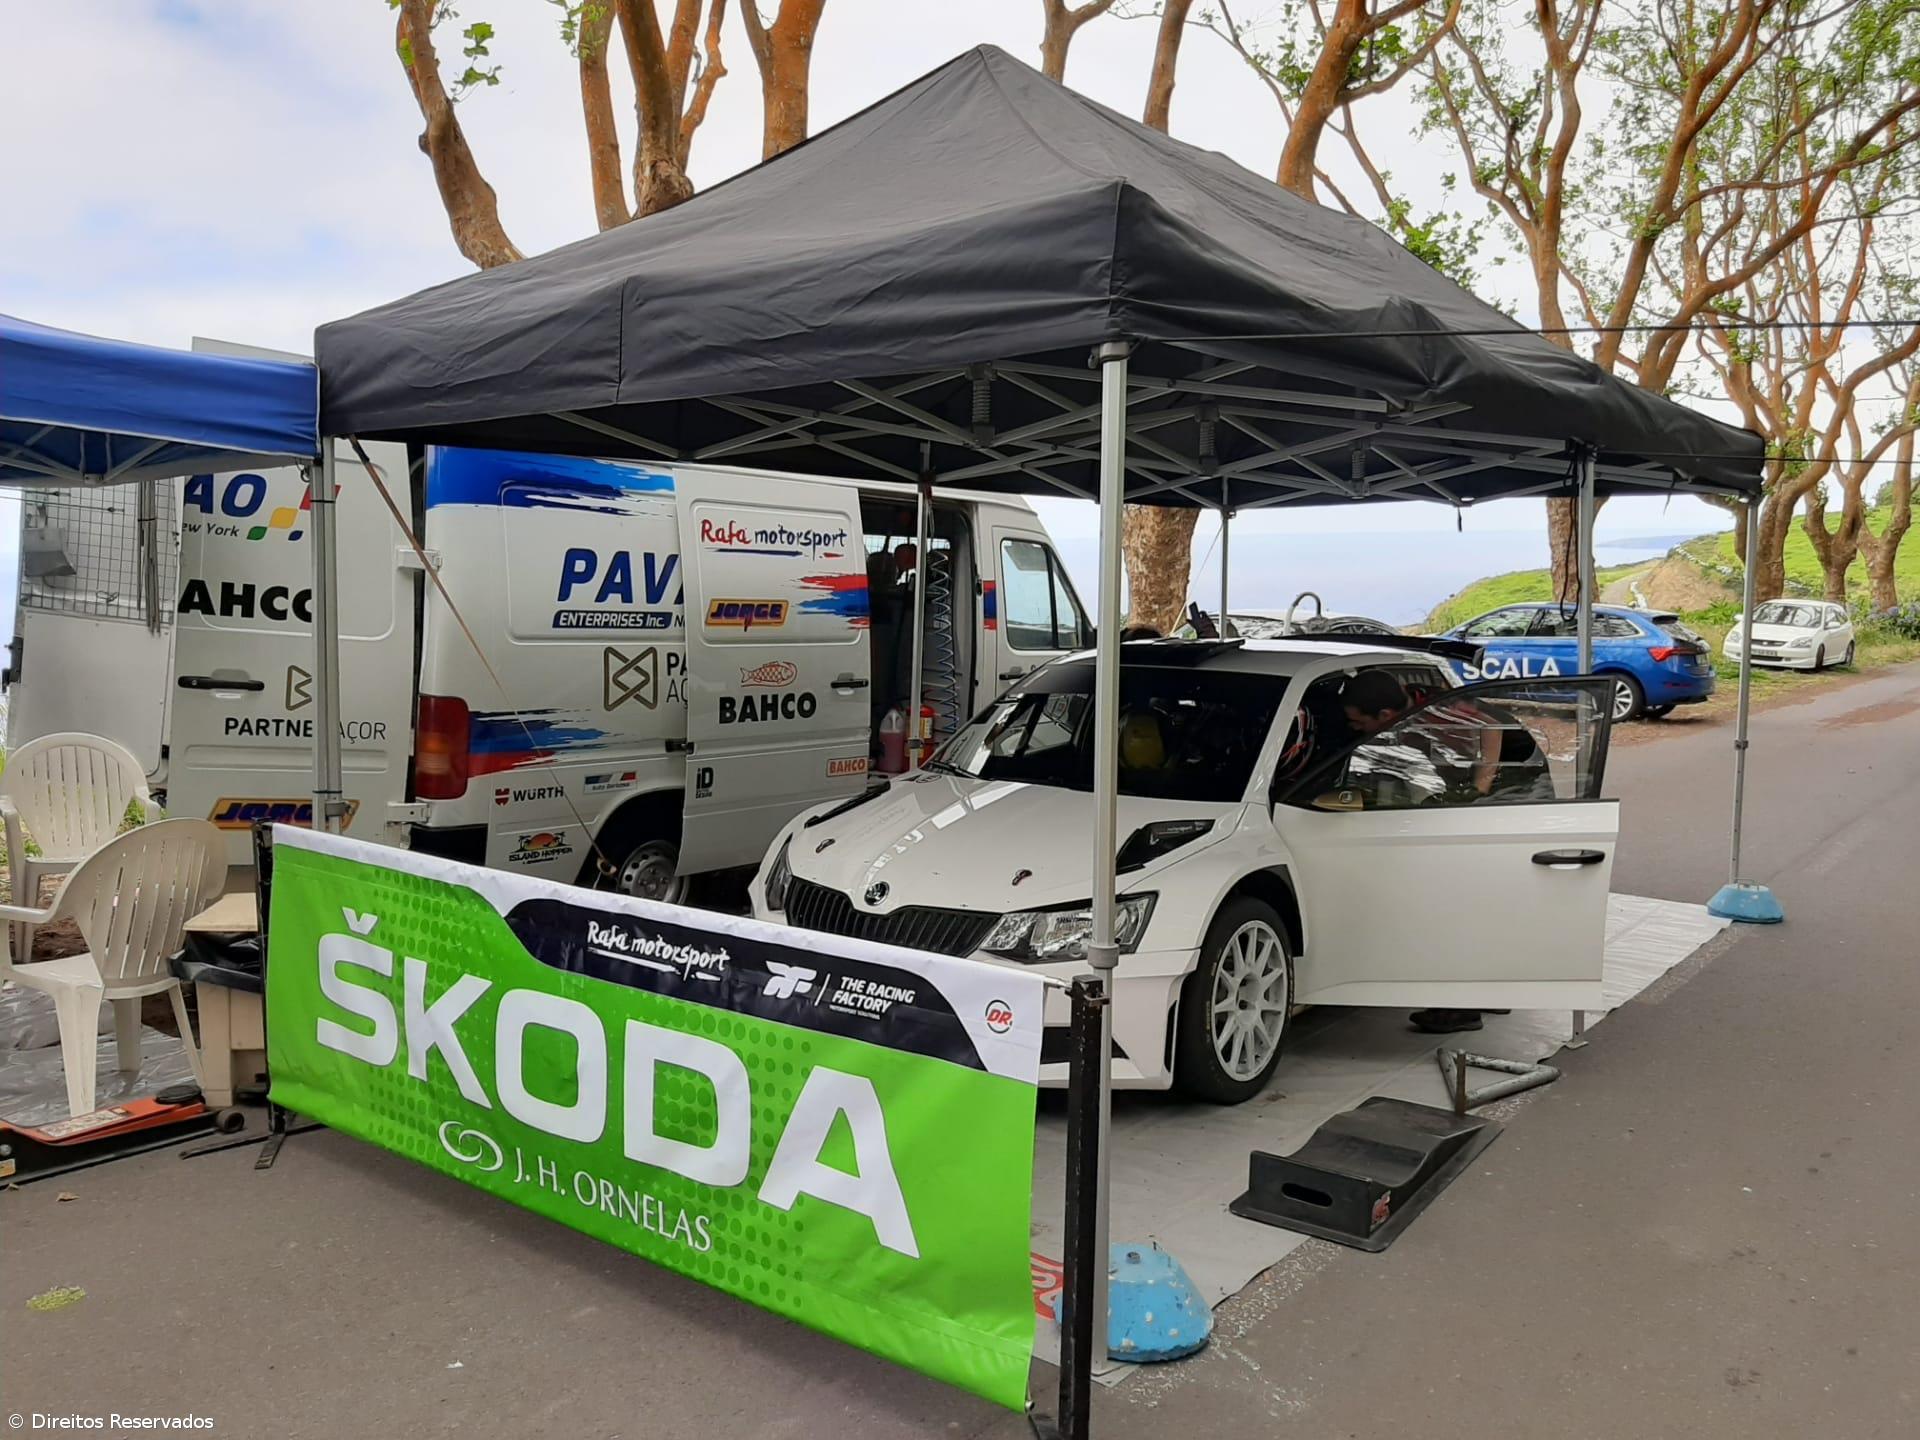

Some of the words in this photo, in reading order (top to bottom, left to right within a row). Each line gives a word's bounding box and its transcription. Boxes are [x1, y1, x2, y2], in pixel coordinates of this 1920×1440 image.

[207, 522, 240, 537] York
[701, 519, 751, 546] Rafa
[754, 524, 848, 561] motorsport
[557, 548, 685, 605] PAV
[559, 612, 644, 627] ENTERPRISES
[710, 602, 783, 632] JORGE
[1462, 656, 1560, 680] SCALA
[719, 692, 817, 724] BAHCO
[829, 758, 866, 774] BAHCO
[513, 786, 564, 802] WÜRTH
[509, 851, 540, 862] ISLAND
[587, 920, 630, 951] Rafa
[630, 933, 730, 981] motorsport
[831, 990, 892, 1014] FACTORY
[840, 976, 867, 993] THE
[866, 982, 916, 1004] RACING
[316, 906, 920, 1259] ŠKODA
[513, 1147, 531, 1183] J.
[537, 1155, 566, 1195] H.
[573, 1171, 712, 1252] ORNELAS
